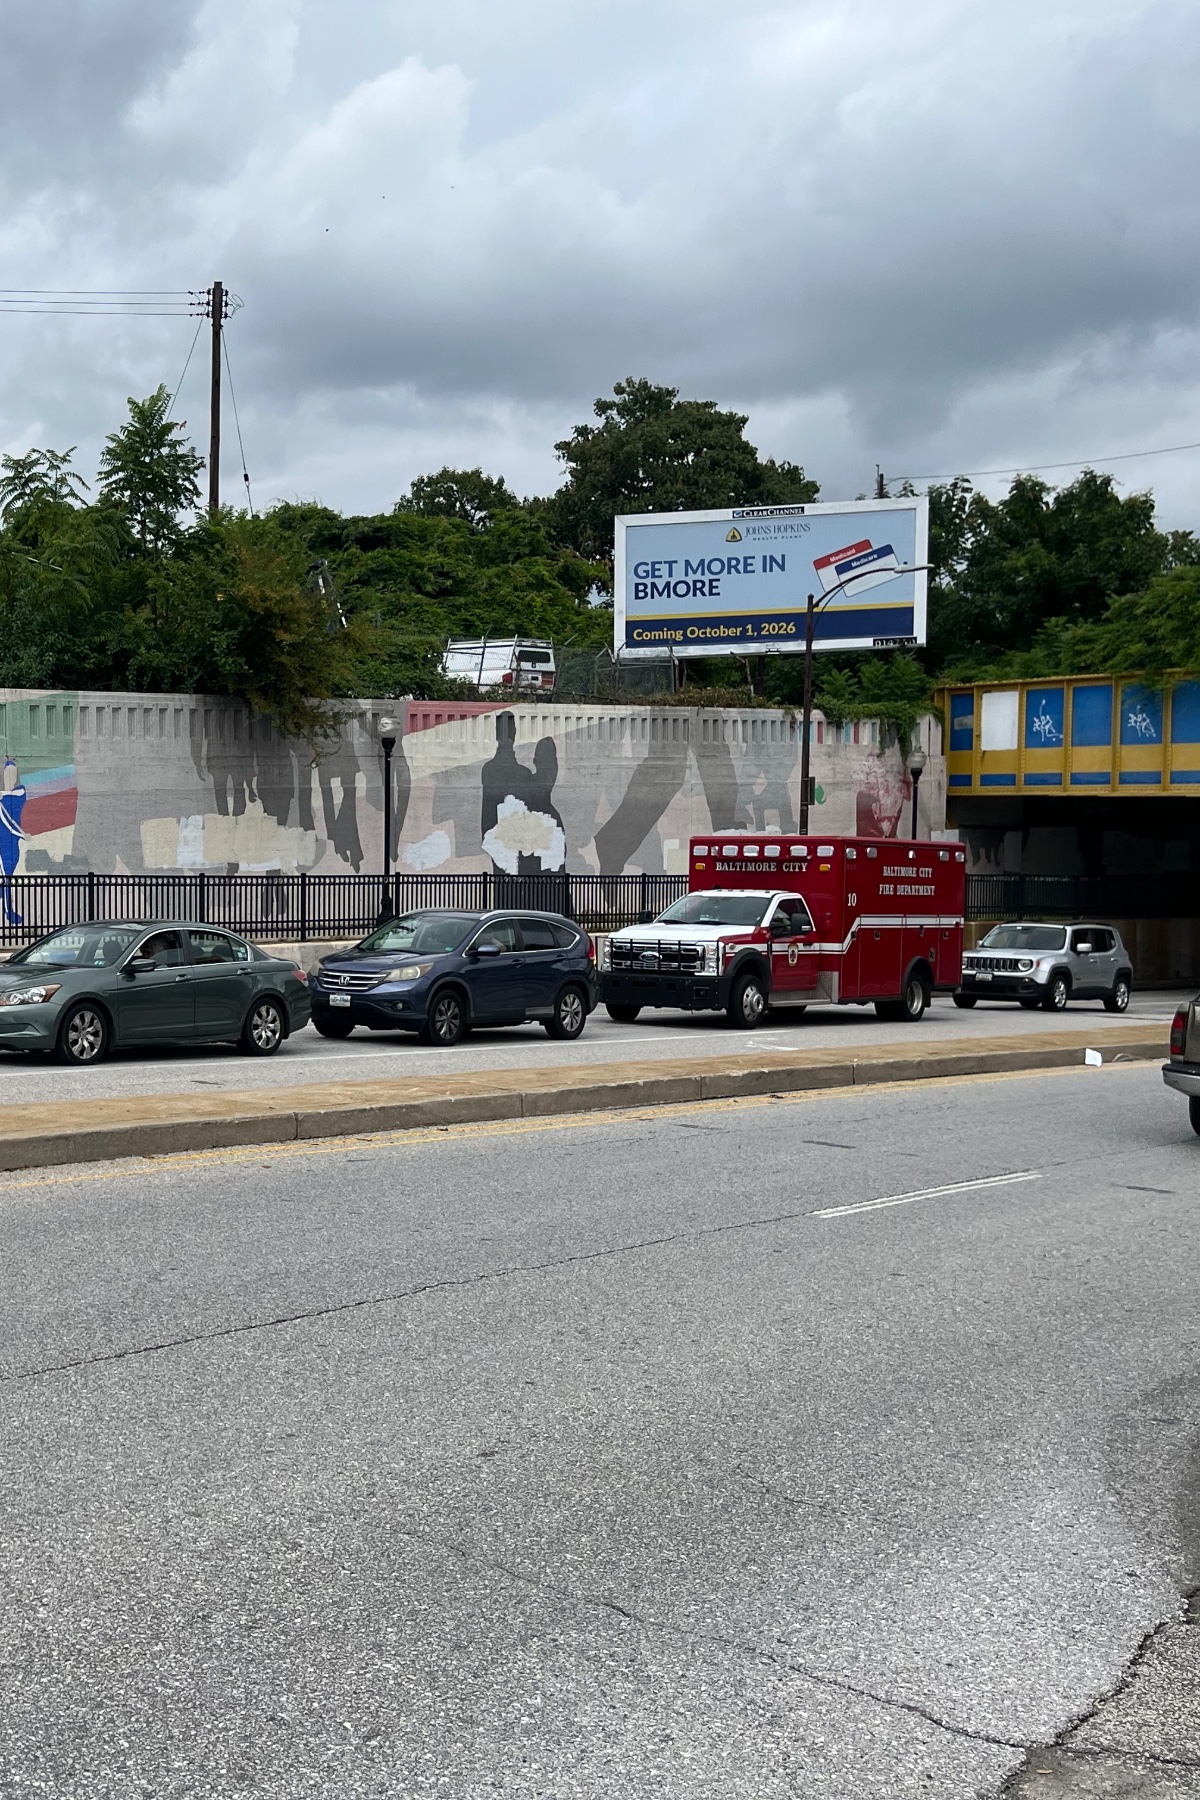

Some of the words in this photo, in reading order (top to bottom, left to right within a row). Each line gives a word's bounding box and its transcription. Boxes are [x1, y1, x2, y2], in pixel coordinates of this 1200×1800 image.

[744, 525, 772, 538] JOHNS
[773, 523, 811, 534] HOPKINS
[634, 560, 678, 579] GET
[684, 556, 756, 577] MORE
[762, 554, 786, 573] IN
[851, 554, 878, 567] Medicare
[634, 578, 720, 600] BMORE
[633, 628, 683, 640] Coming
[686, 625, 742, 638] October
[746, 624, 757, 637] 1,
[760, 622, 796, 635] 2026
[716, 862, 777, 872] BALTIMORE
[782, 862, 808, 872] CITY
[883, 866, 916, 877] BALTIMORE
[919, 868, 932, 878] CITY
[879, 884, 894, 894] FIRE
[897, 884, 935, 896] DEPARTMENT
[848, 892, 856, 906] 10
